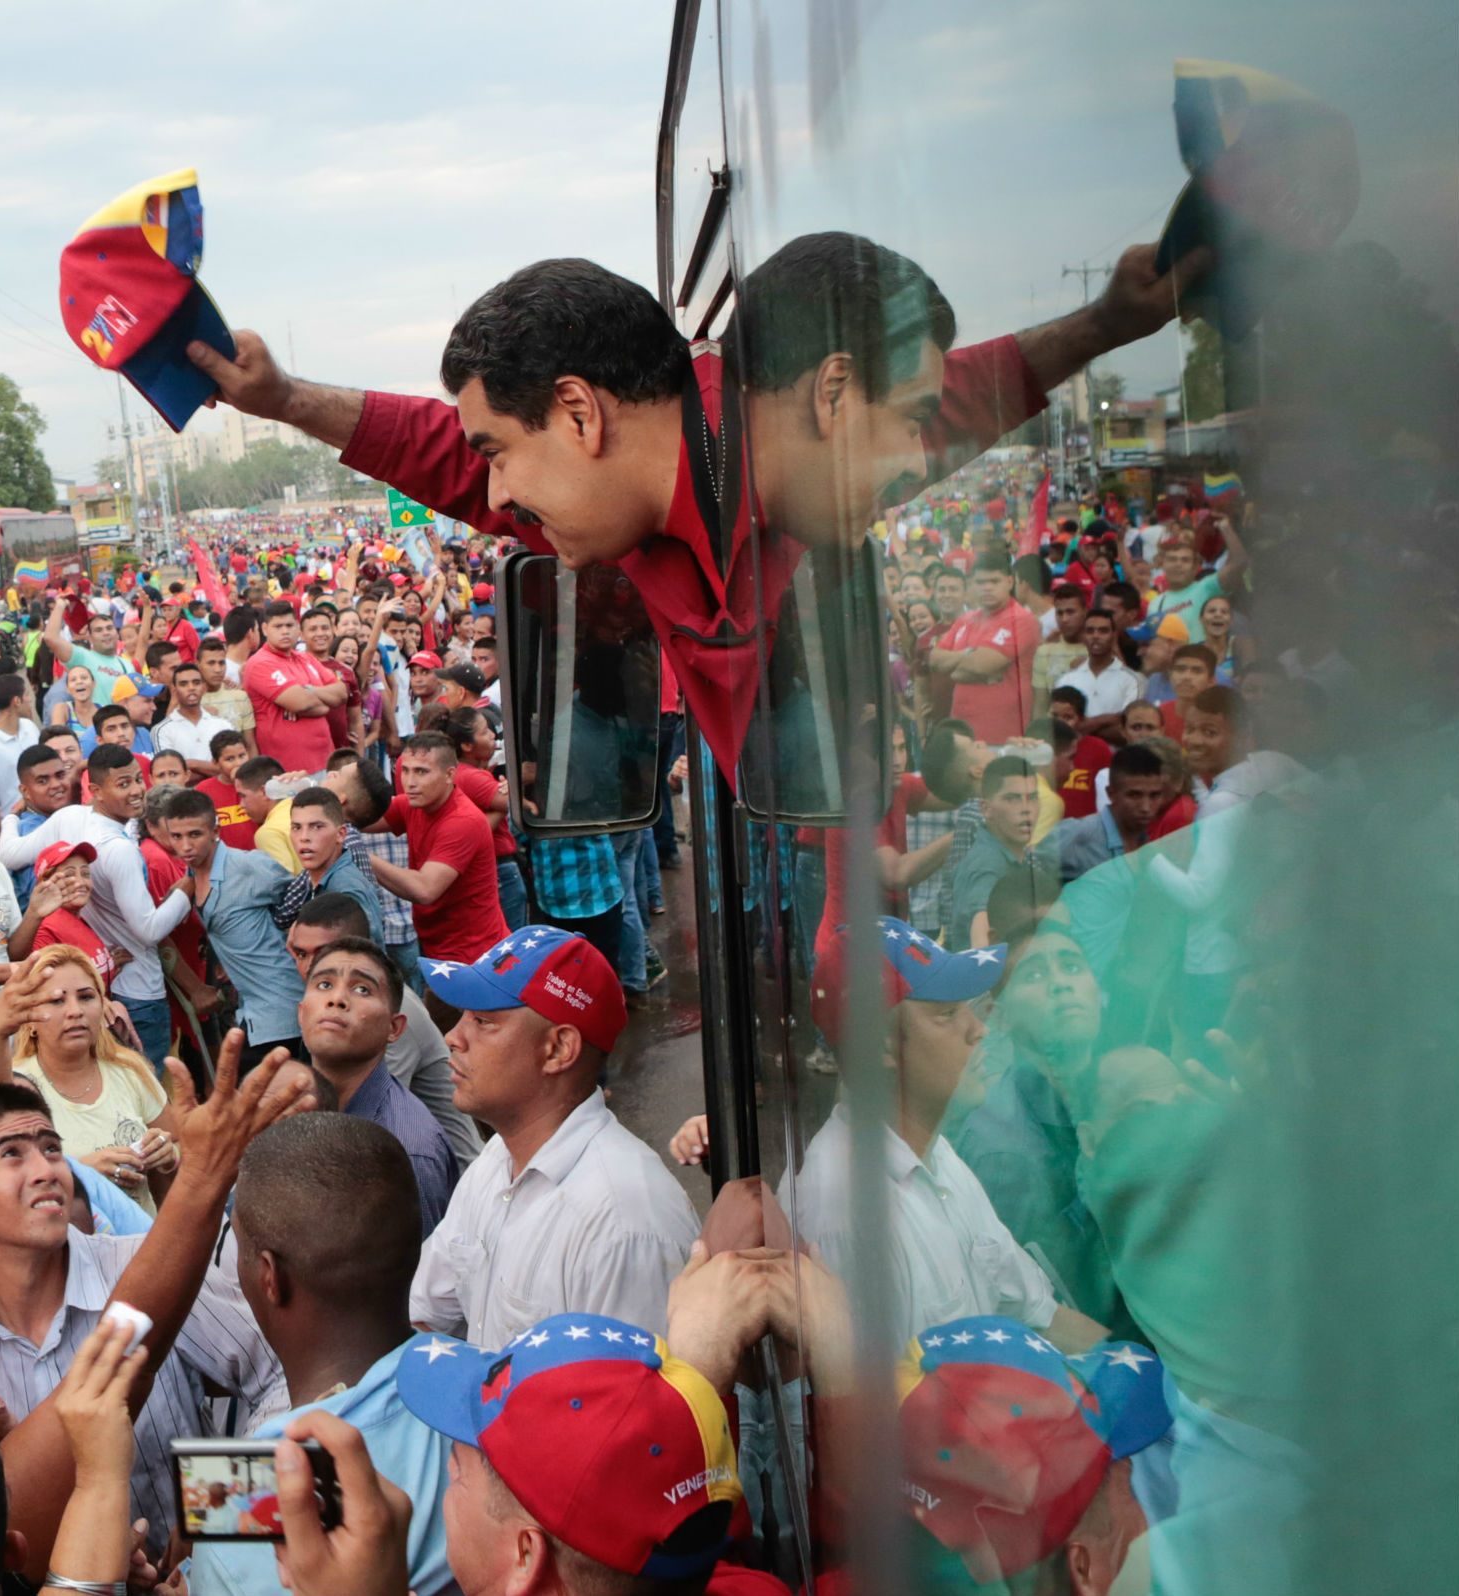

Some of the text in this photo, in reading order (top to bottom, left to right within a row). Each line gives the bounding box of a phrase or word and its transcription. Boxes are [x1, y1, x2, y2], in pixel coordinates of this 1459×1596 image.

[271, 669, 288, 686] 3
[546, 971, 567, 989] Trabajo
[567, 985, 576, 994] en
[544, 981, 586, 1010] Triunfo Seguro
